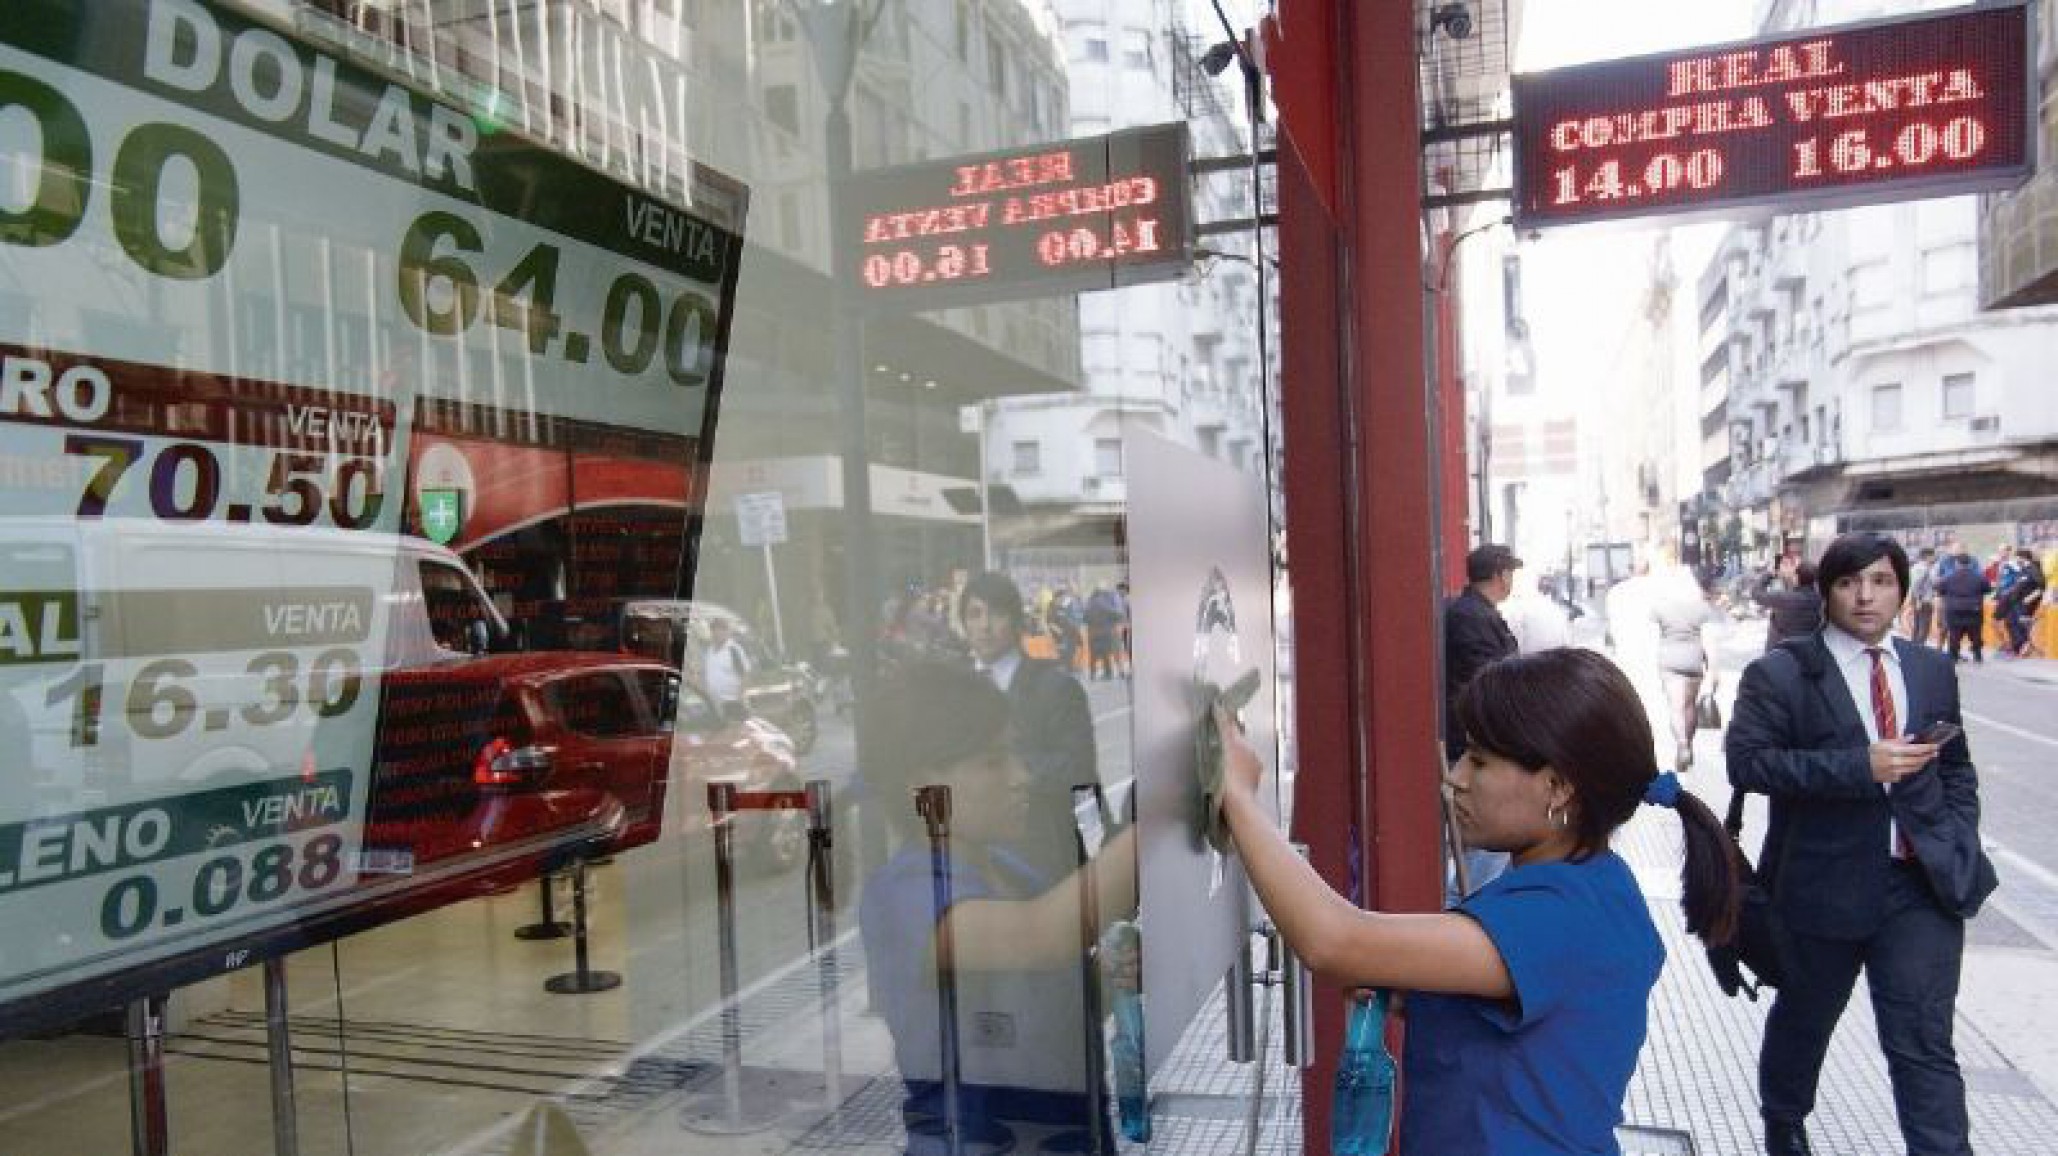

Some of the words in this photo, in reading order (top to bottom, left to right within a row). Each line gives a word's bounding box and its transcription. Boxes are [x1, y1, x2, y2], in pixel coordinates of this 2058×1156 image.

[145, 0, 478, 191] DOLAR
[1668, 40, 1845, 96] REAL
[1551, 97, 1773, 151] COMPRA
[1785, 69, 1984, 122] VENTA
[1554, 149, 1723, 204] 14.00
[1794, 116, 1985, 178] 16.00
[627, 199, 718, 266] VENTA
[399, 210, 718, 386] 64.00
[0, 356, 111, 422] RO
[287, 403, 384, 442] VENTA
[63, 434, 384, 530] 70.50
[263, 604, 361, 635] VENTA
[46, 648, 361, 747] 16.30
[0, 808, 171, 886] ENO
[243, 786, 340, 828] VENTA
[102, 834, 343, 940] 0.088
